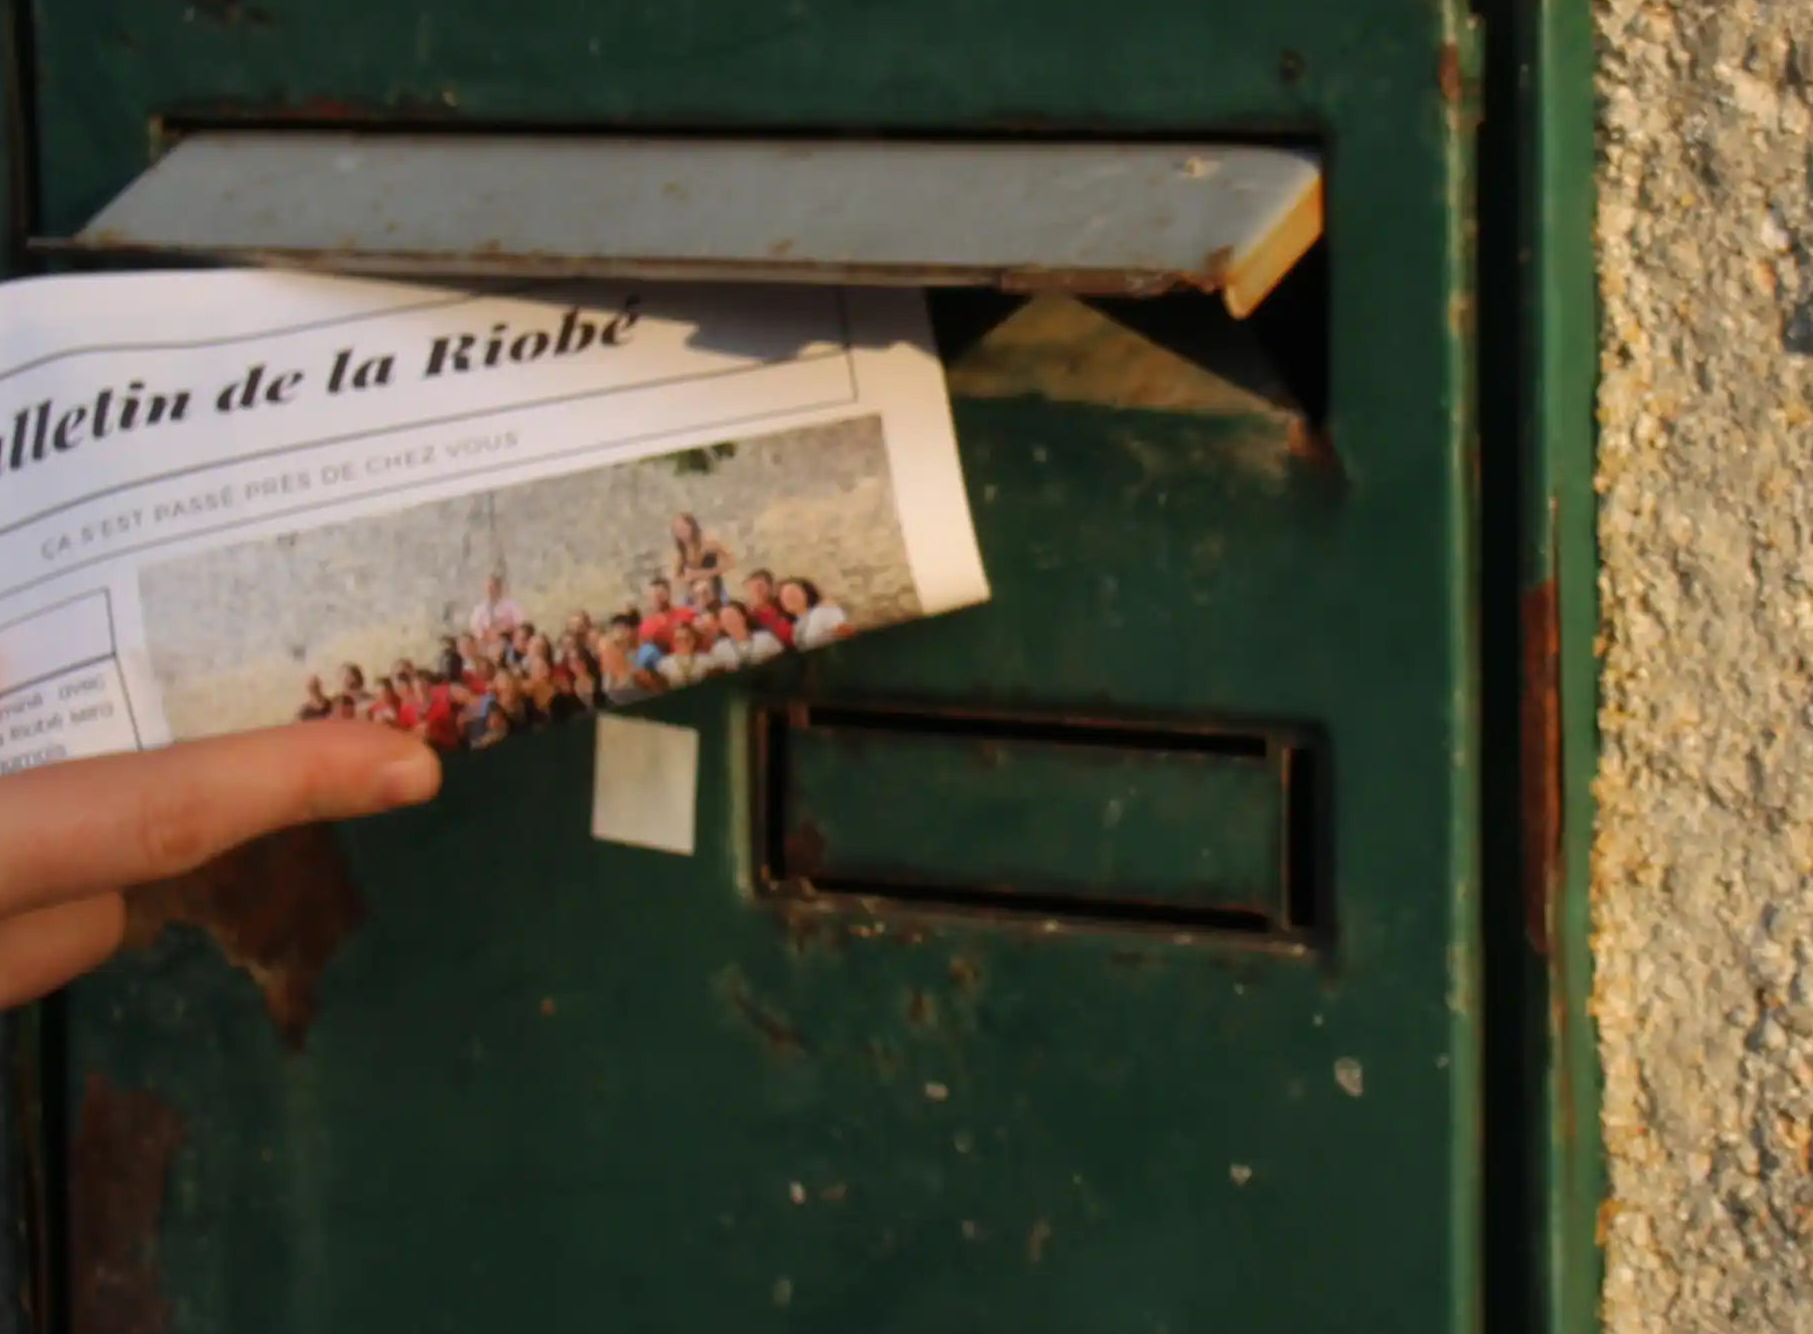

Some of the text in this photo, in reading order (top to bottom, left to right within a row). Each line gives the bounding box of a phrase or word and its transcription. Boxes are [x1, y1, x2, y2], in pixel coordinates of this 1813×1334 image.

[215, 363, 304, 413] de
[327, 348, 396, 394] la
[424, 294, 641, 378] Riobé
[320, 462, 357, 486] DE
[365, 446, 436, 475] CHEZ
[445, 430, 519, 459] VOUS
